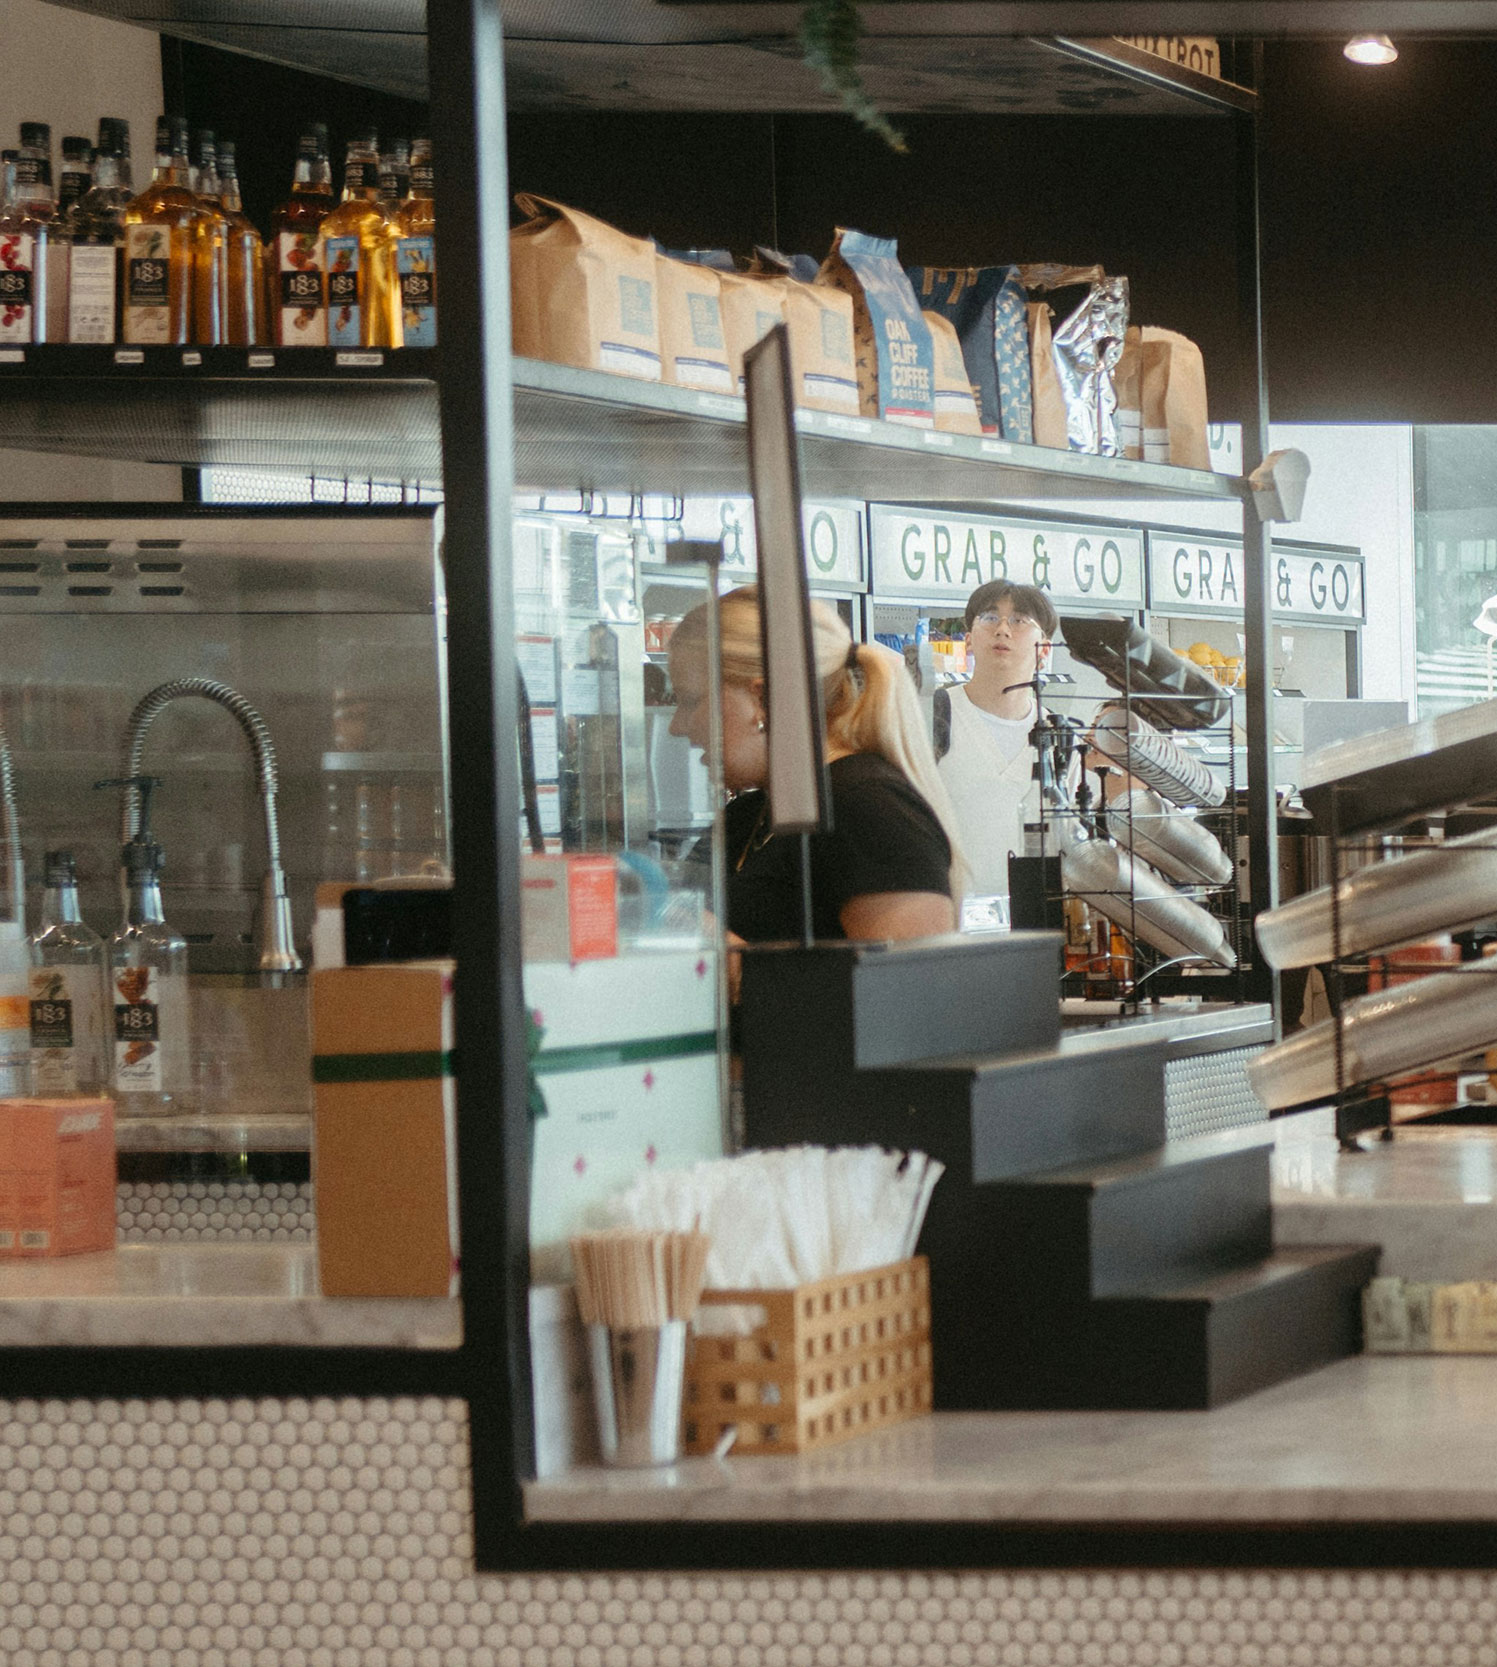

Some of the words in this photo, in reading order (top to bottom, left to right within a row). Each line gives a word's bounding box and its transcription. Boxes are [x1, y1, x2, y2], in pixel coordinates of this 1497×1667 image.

[885, 319, 911, 342] OAK
[889, 341, 918, 365] CLIFF
[891, 365, 930, 390] COFFEE
[901, 523, 1008, 584] GRAB
[1032, 533, 1052, 590] &
[1073, 537, 1122, 593] GO
[1173, 547, 1239, 602] GRA
[1276, 558, 1292, 607] &
[1309, 561, 1349, 611] GO
